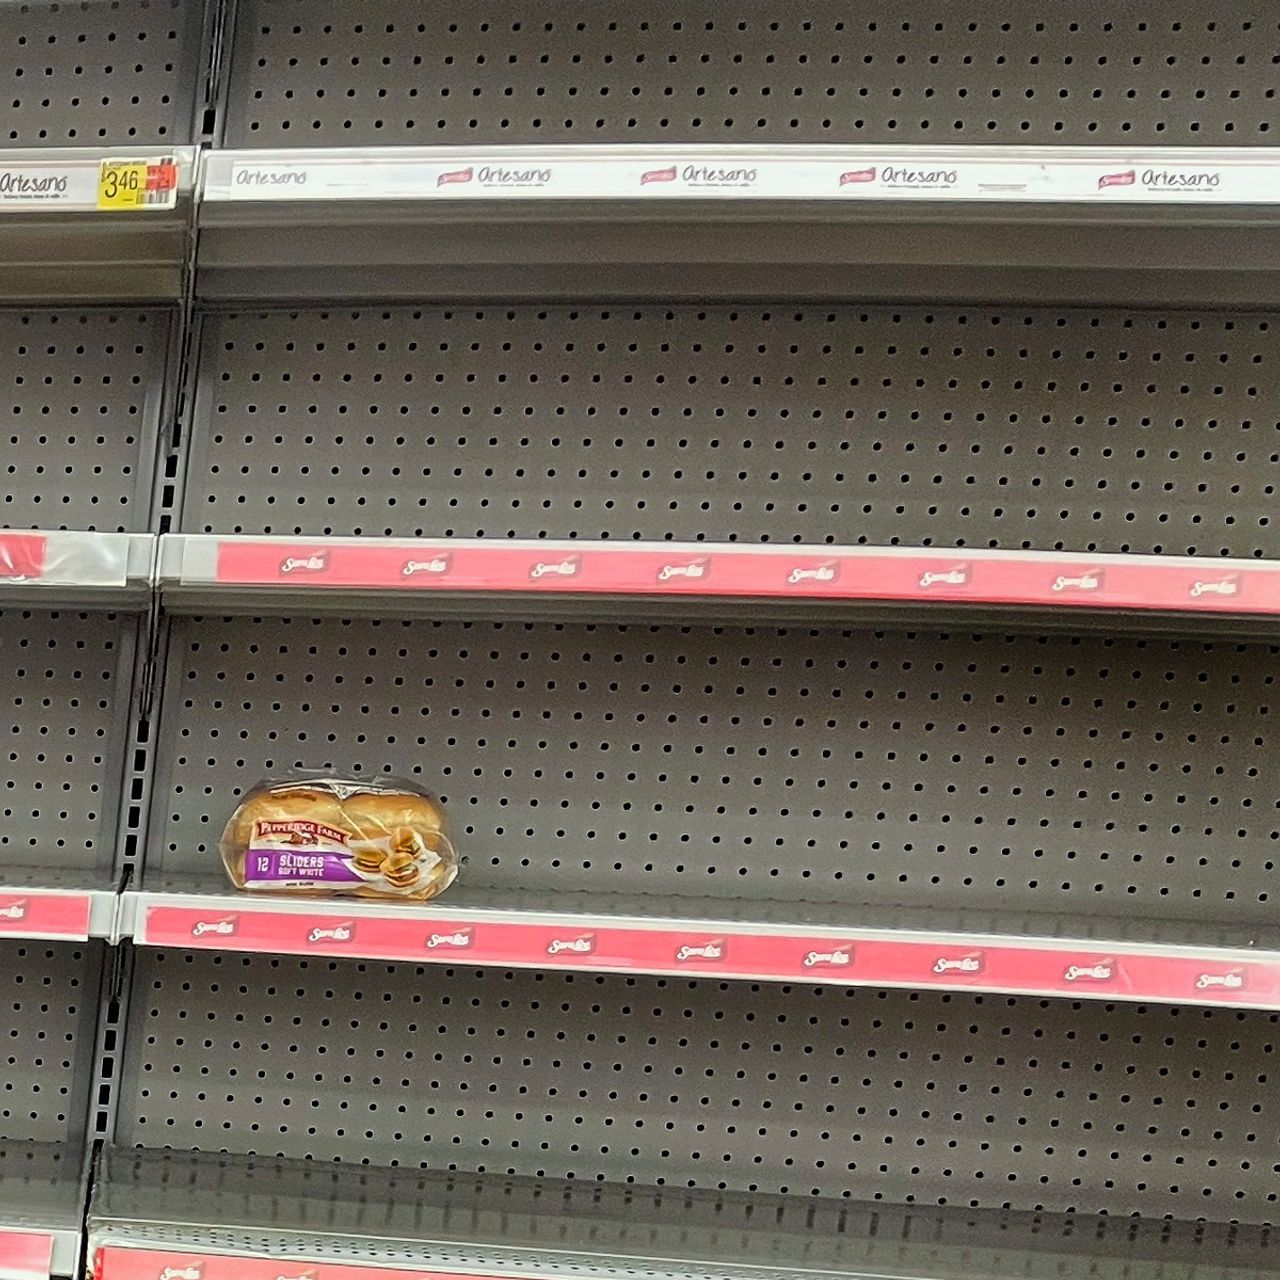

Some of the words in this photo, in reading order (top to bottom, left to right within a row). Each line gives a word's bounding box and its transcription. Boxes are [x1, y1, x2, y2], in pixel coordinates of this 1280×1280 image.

[104, 170, 138, 198] 346
[257, 857, 269, 872] 12
[280, 855, 324, 868] SLIDERS
[278, 867, 297, 875] SOFT
[298, 867, 324, 876] WHITE
